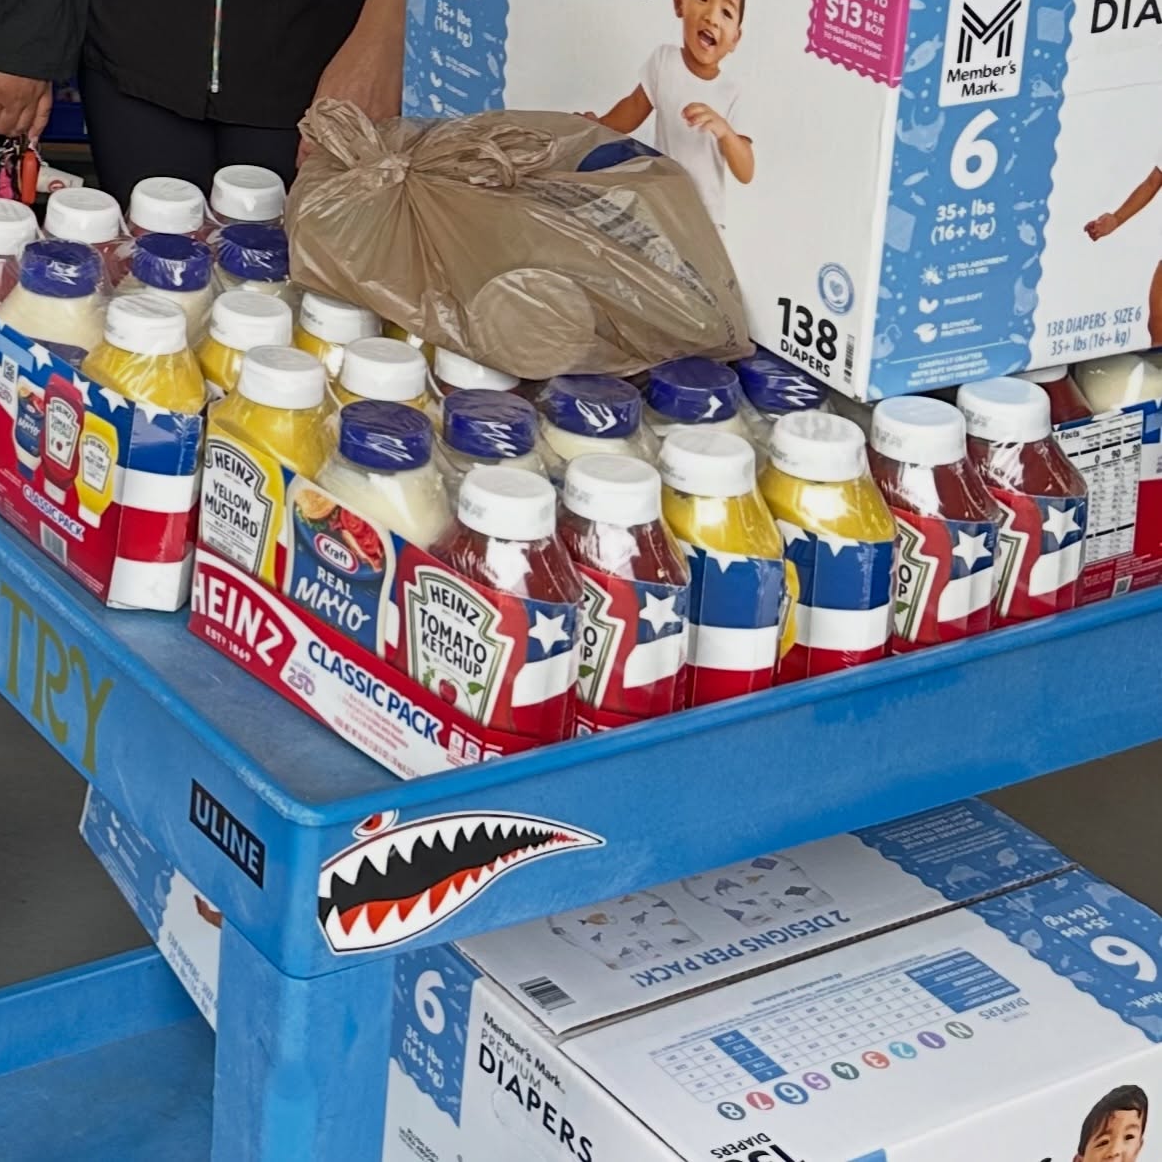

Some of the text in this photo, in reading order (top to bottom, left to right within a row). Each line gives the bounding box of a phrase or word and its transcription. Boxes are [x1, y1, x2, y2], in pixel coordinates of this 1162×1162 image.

[864, 21, 884, 37] BOX
[866, 9, 885, 25] PER
[946, 59, 1018, 85] Member's
[961, 79, 999, 99] Mark
[949, 108, 999, 191] 6
[930, 216, 996, 246] (16+ kg)
[935, 198, 996, 224] 35+ lbs
[777, 296, 838, 363] 138
[1046, 305, 1142, 336] 138 DIAPERS SIZE 6
[1050, 327, 1131, 357] 35+ lbs (16+ kg)
[780, 339, 832, 380] DIAPERS
[214, 451, 256, 488] HEINZ
[204, 495, 259, 539] MUSTARD
[212, 478, 252, 514] YELLOW
[322, 541, 350, 565] Kraft
[295, 576, 370, 632] MAYO
[317, 564, 353, 600] REAL
[190, 572, 283, 667] HEINZ
[429, 583, 481, 626] HEINZ
[419, 607, 488, 665] TOMATO
[421, 633, 484, 678] KETCHUP
[308, 639, 387, 712] CLASSIC
[387, 690, 443, 746] PACK
[195, 798, 263, 879] ULINE
[631, 910, 851, 988] 2 DESIGNS PER PACK!
[1089, 934, 1158, 983] 6
[414, 969, 446, 1036] 6
[481, 1028, 542, 1093] PREMIUM
[483, 1011, 562, 1089] Member's Mark
[478, 1042, 593, 1162] DIAPERS
